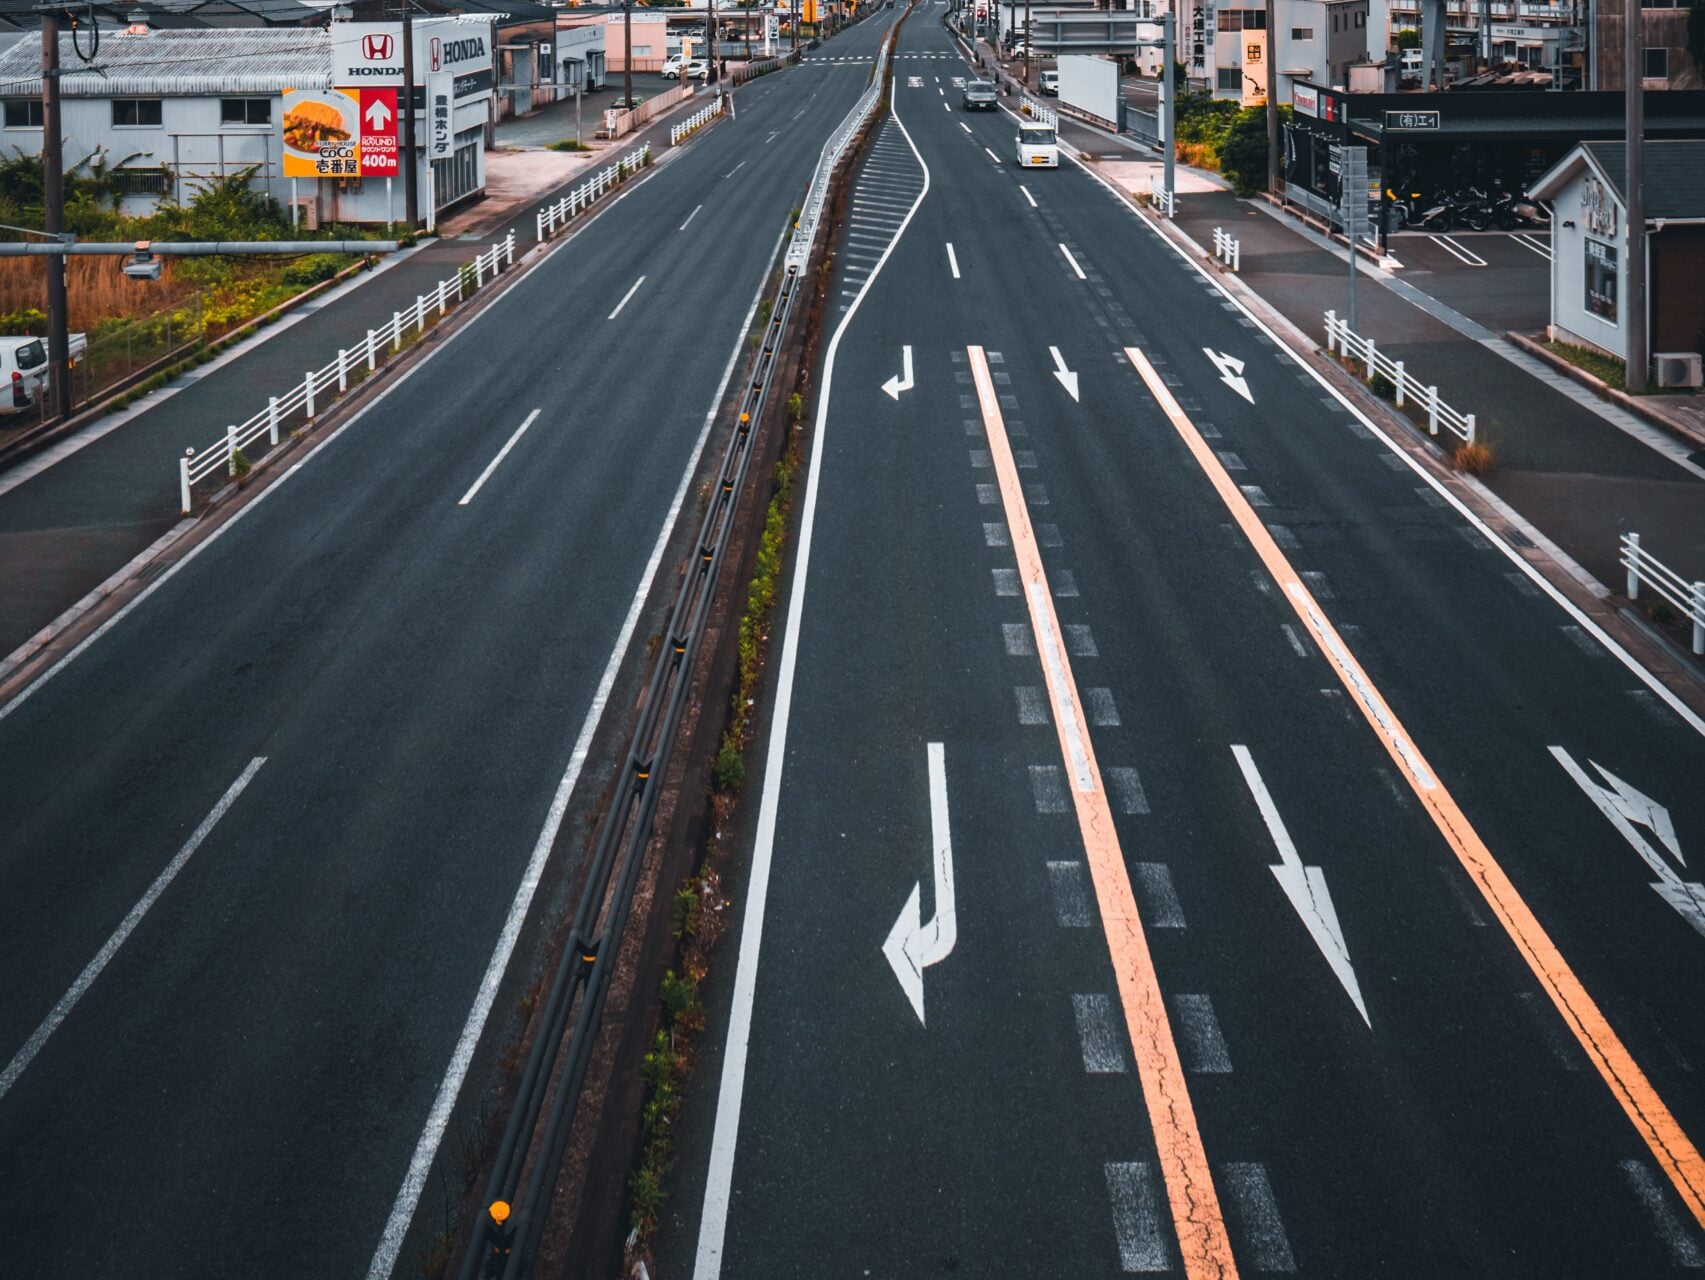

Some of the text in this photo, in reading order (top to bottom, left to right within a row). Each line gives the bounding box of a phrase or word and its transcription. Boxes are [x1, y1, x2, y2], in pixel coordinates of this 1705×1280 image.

[443, 37, 486, 65] HONDA
[348, 67, 405, 76] HONDA
[434, 95, 449, 153] 豊橋ホンダ
[362, 135, 395, 146] ROUND1
[320, 147, 353, 158] CoCo
[362, 154, 396, 166] 400m
[316, 159, 358, 174] 壱番屋
